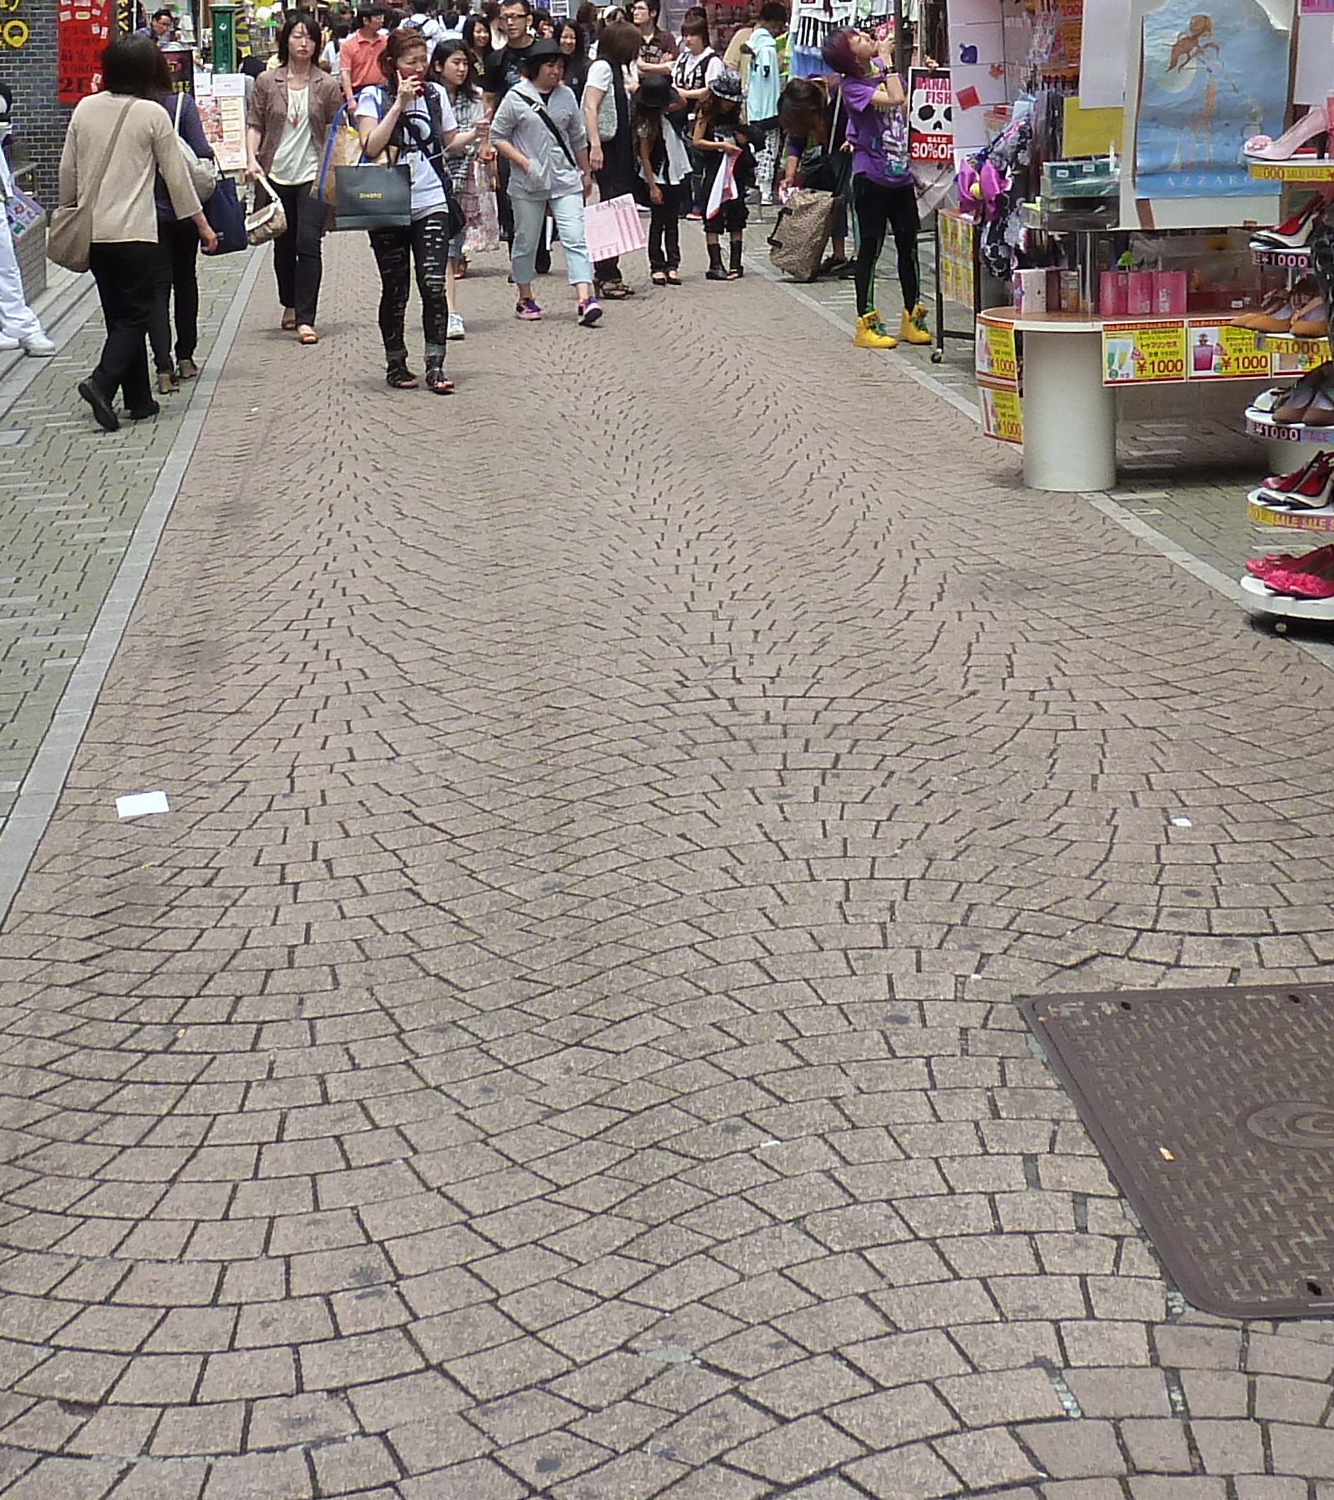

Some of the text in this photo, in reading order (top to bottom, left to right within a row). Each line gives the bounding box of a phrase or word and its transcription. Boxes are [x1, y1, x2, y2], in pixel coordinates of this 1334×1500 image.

[925, 91, 952, 105] FISH
[1276, 341, 1321, 355] ¥1000
[989, 357, 1015, 373] ¥1000
[1136, 358, 1185, 375] ¥1000
[1221, 355, 1268, 370] ¥1000
[997, 421, 1022, 437] ¥1000
[1255, 427, 1299, 441] ¥1000
[1275, 514, 1299, 528] SALE
[1301, 517, 1326, 530] SALE
